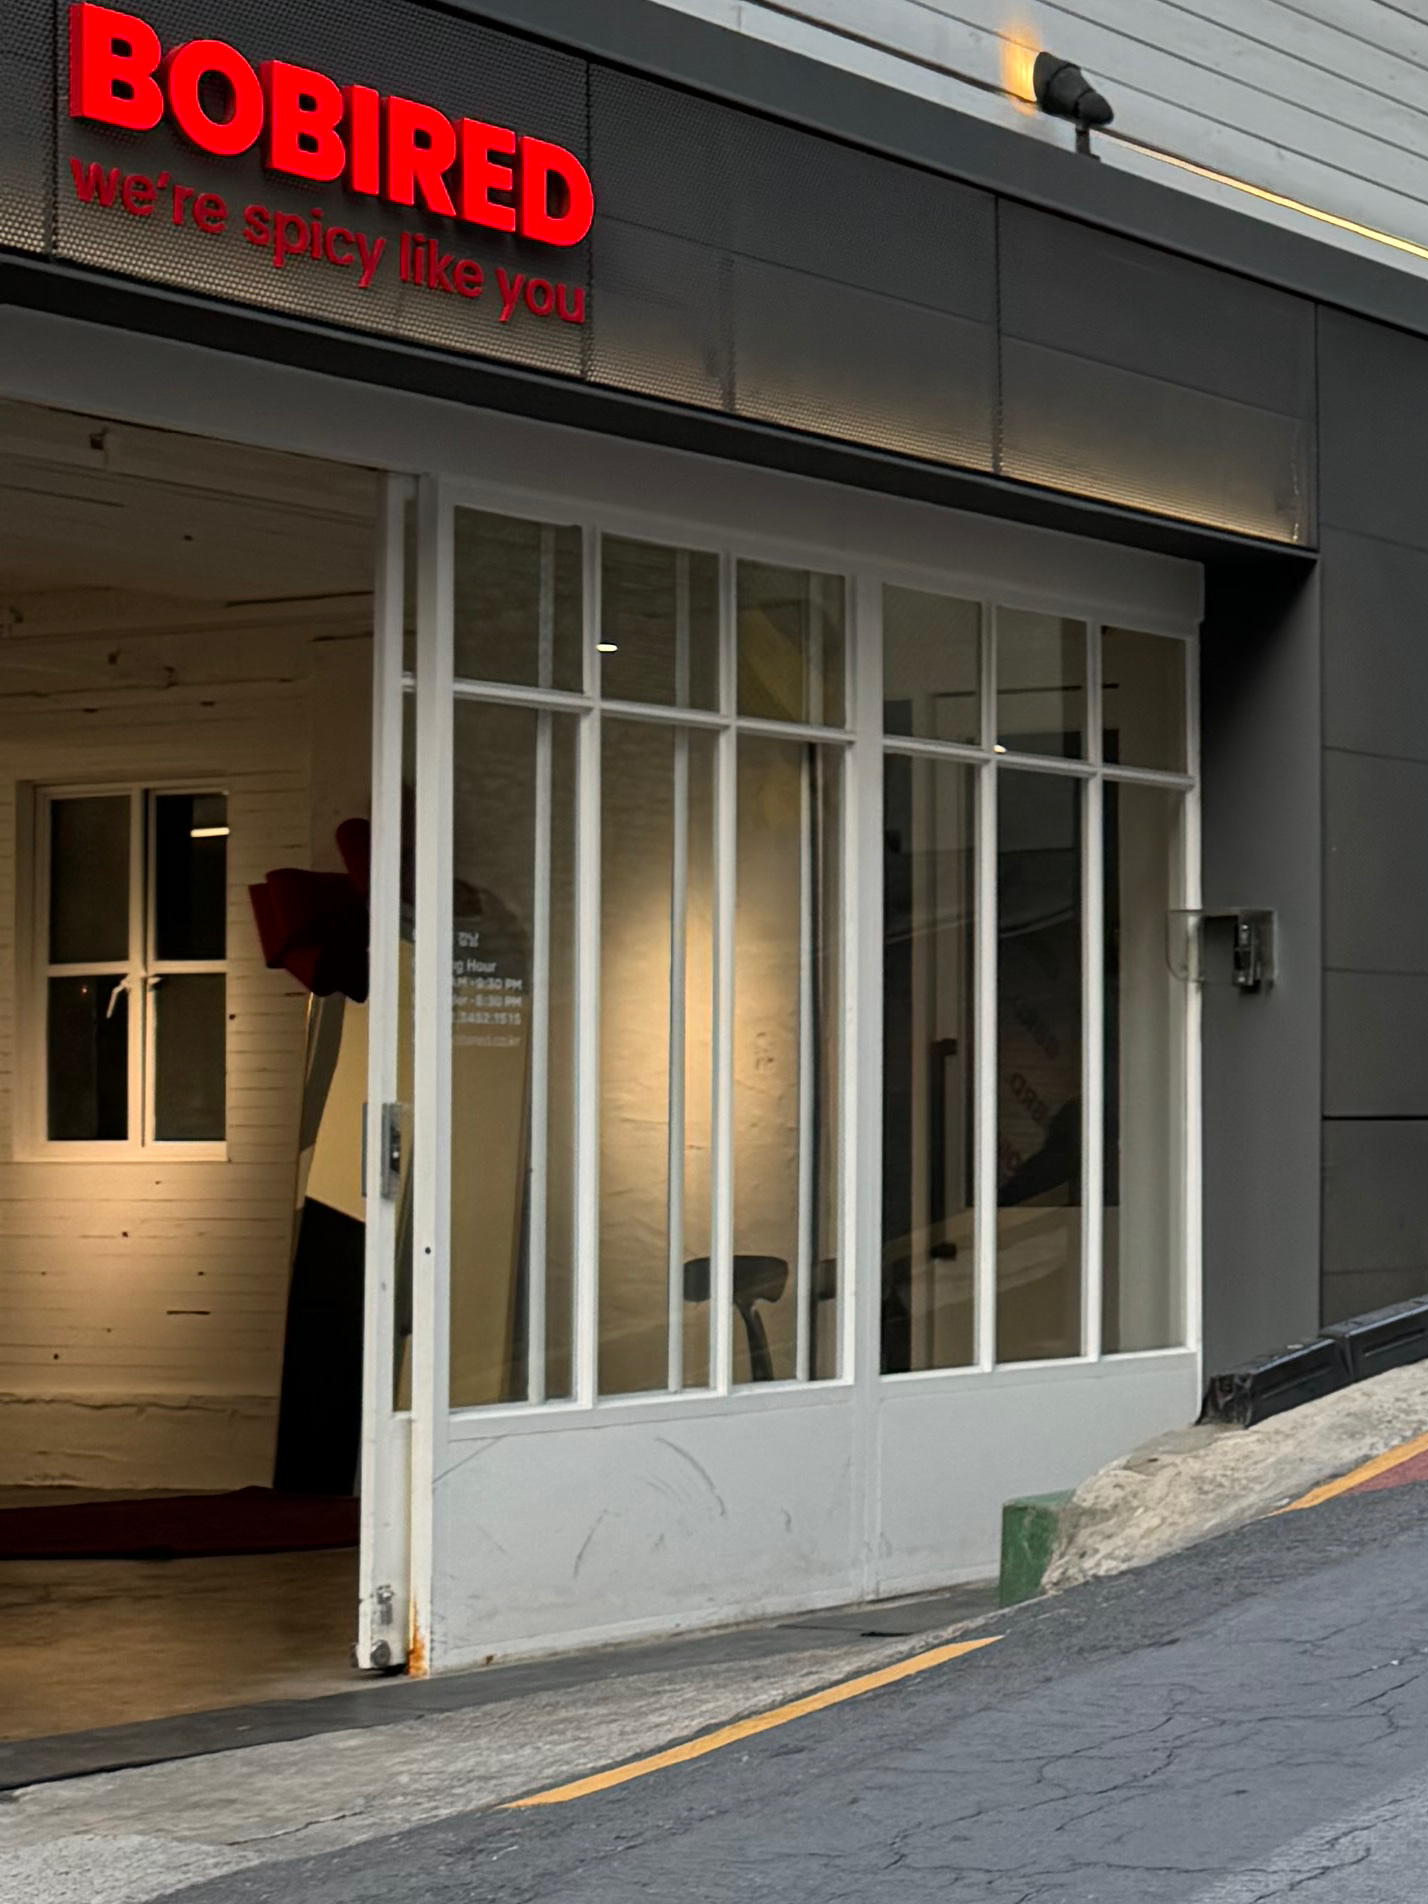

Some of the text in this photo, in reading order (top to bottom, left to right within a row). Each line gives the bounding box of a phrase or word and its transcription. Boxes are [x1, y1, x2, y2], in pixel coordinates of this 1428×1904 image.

[69, 2, 595, 248] BOBIRED
[70, 156, 587, 324] we're spicy like you
[467, 959, 497, 973] Hour
